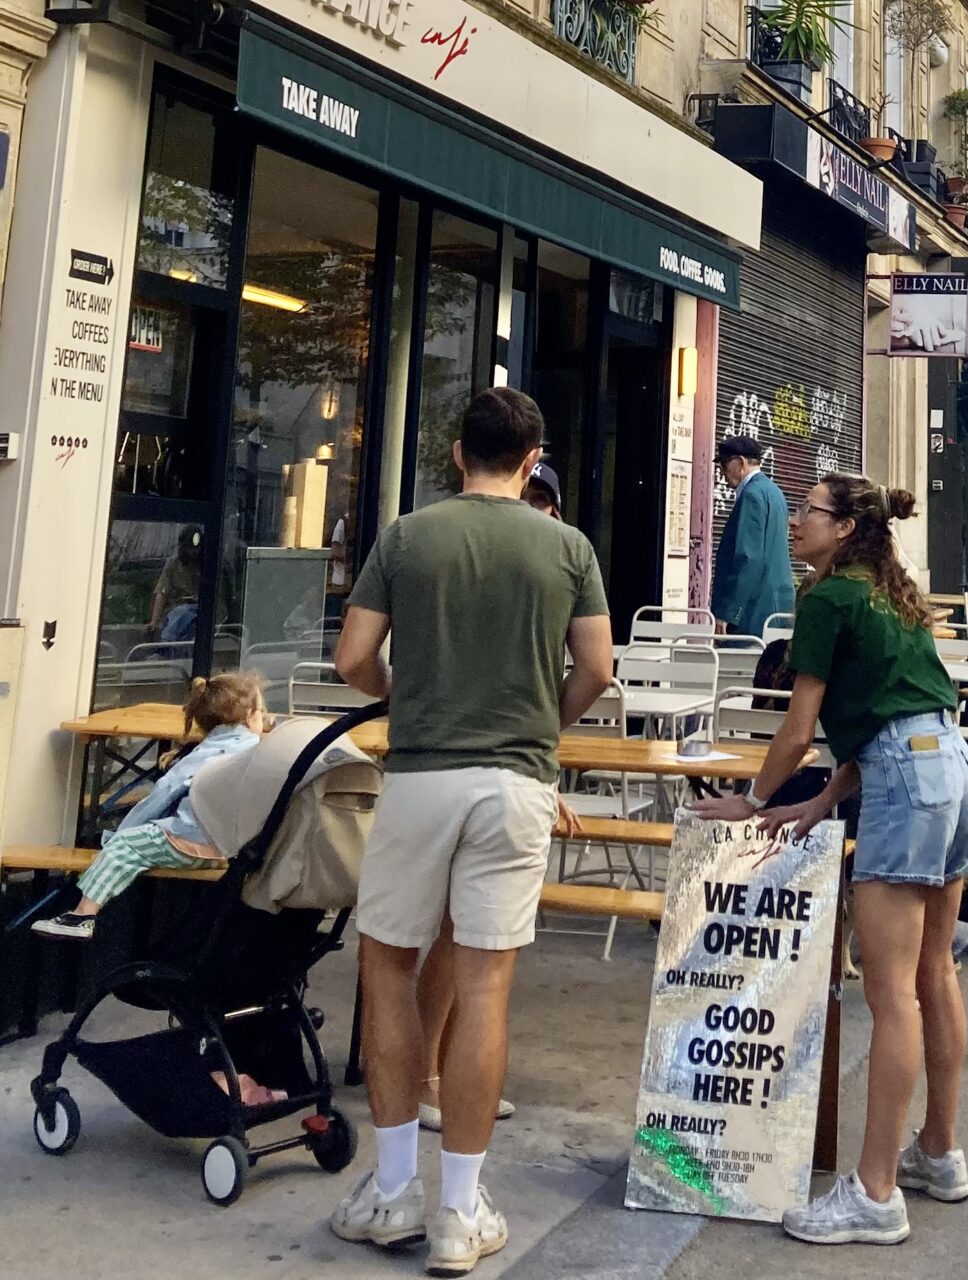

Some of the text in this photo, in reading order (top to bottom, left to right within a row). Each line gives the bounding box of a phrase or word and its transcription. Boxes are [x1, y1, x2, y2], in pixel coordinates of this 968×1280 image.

[282, 76, 360, 138] TAKE AWAY
[840, 152, 863, 196] ELLY
[863, 170, 885, 212] NAIL
[73, 259, 90, 272] ORDER
[660, 246, 727, 293] FOOD. COFFEE. GOODS.
[893, 276, 968, 292] ELLY NAIL
[65, 289, 112, 316] TAKE AWAY
[71, 320, 109, 345] COFFEES
[60, 378, 77, 399] THE
[78, 381, 104, 403] MENU
[712, 826, 733, 844] LA
[704, 881, 813, 922] WE ARE
[703, 922, 801, 962] OPEN !
[666, 969, 745, 990] OH REALLY?
[704, 1004, 775, 1036] GOOD
[688, 1037, 785, 1072] GOSSIPS
[692, 1073, 771, 1109] HERE !
[646, 1112, 727, 1136] OH REALLY?
[705, 1148, 729, 1159] FRIDAY
[731, 1150, 750, 1162] 8H30
[752, 1152, 773, 1164] 17H30
[721, 1160, 755, 1173] 9H30-18H
[718, 1172, 749, 1184] TUESDAY
